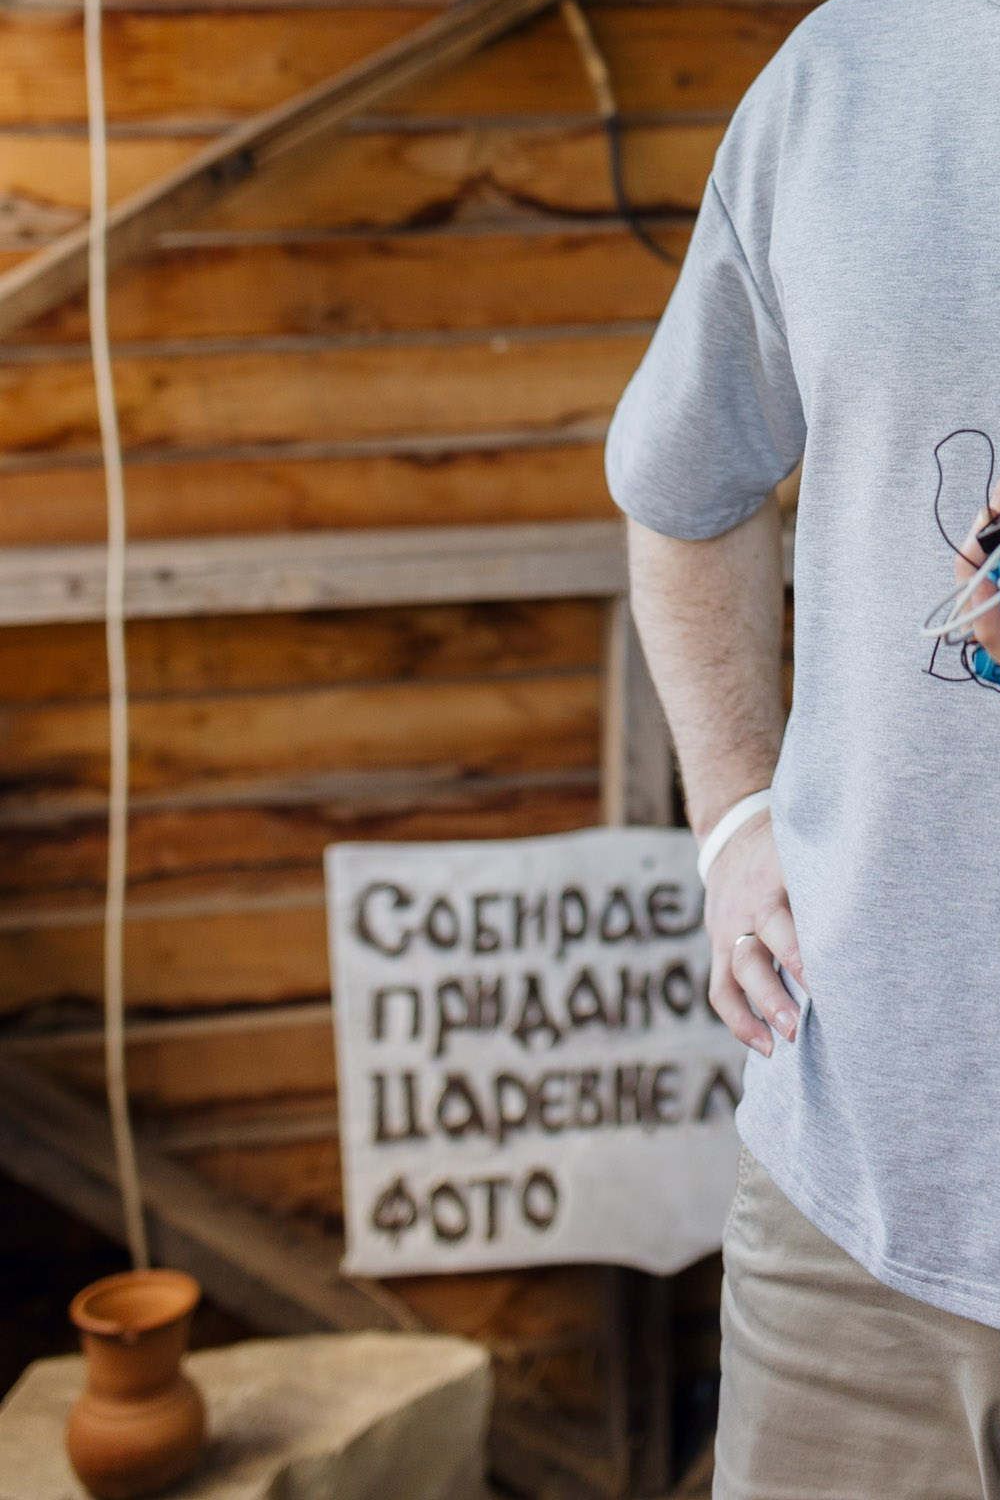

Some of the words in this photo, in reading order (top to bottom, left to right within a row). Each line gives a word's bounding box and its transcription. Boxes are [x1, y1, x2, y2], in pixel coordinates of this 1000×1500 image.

[355, 881, 706, 958] СОБИРАЕ
[371, 1062, 684, 1146] ЦАРЕВНЕ
[371, 1169, 560, 1248] ФОТО
